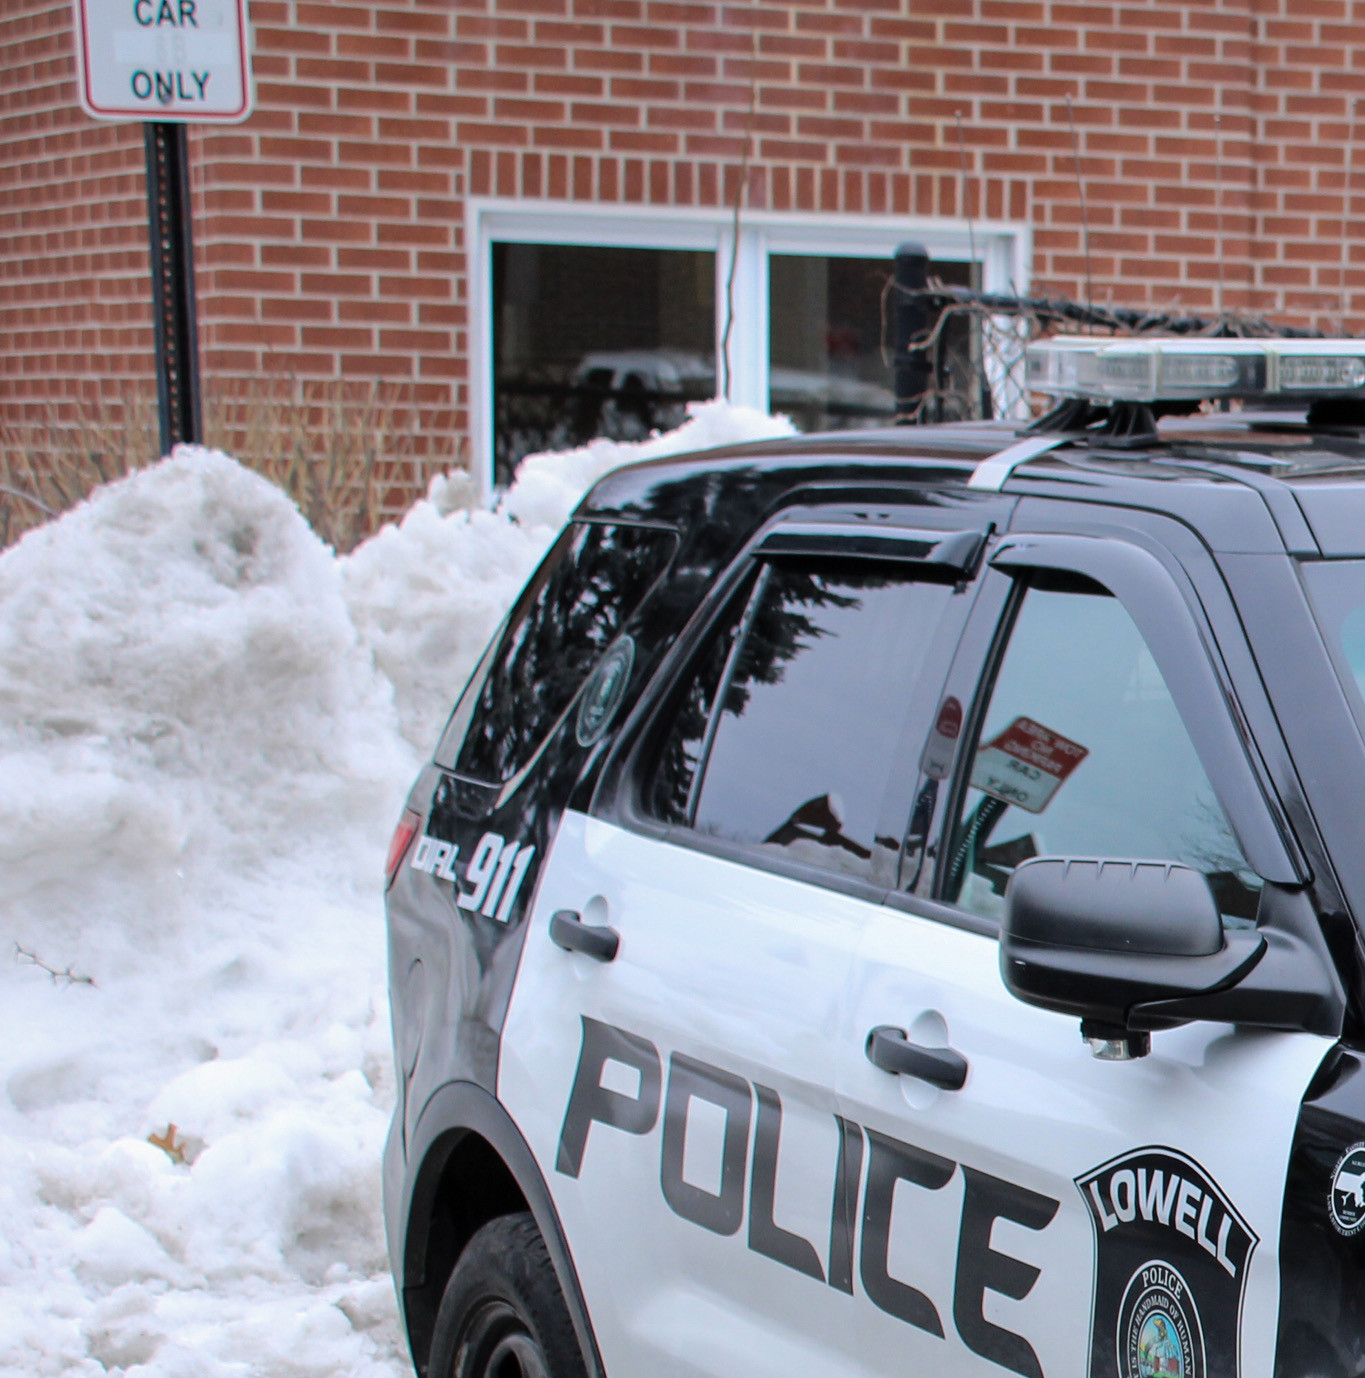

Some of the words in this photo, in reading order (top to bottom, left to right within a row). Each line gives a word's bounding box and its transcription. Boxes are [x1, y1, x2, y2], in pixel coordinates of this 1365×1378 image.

[134, 0, 199, 27] CAR
[132, 70, 210, 100] ONLY
[410, 835, 460, 882] DIAL
[457, 832, 536, 923] 911
[1089, 1168, 1236, 1278] LOWELL
[1142, 1267, 1183, 1299] POLICE
[1135, 1294, 1169, 1325] HANDMAID
[1169, 1303, 1179, 1320] OF
[1177, 1320, 1192, 1375] HUMAN
